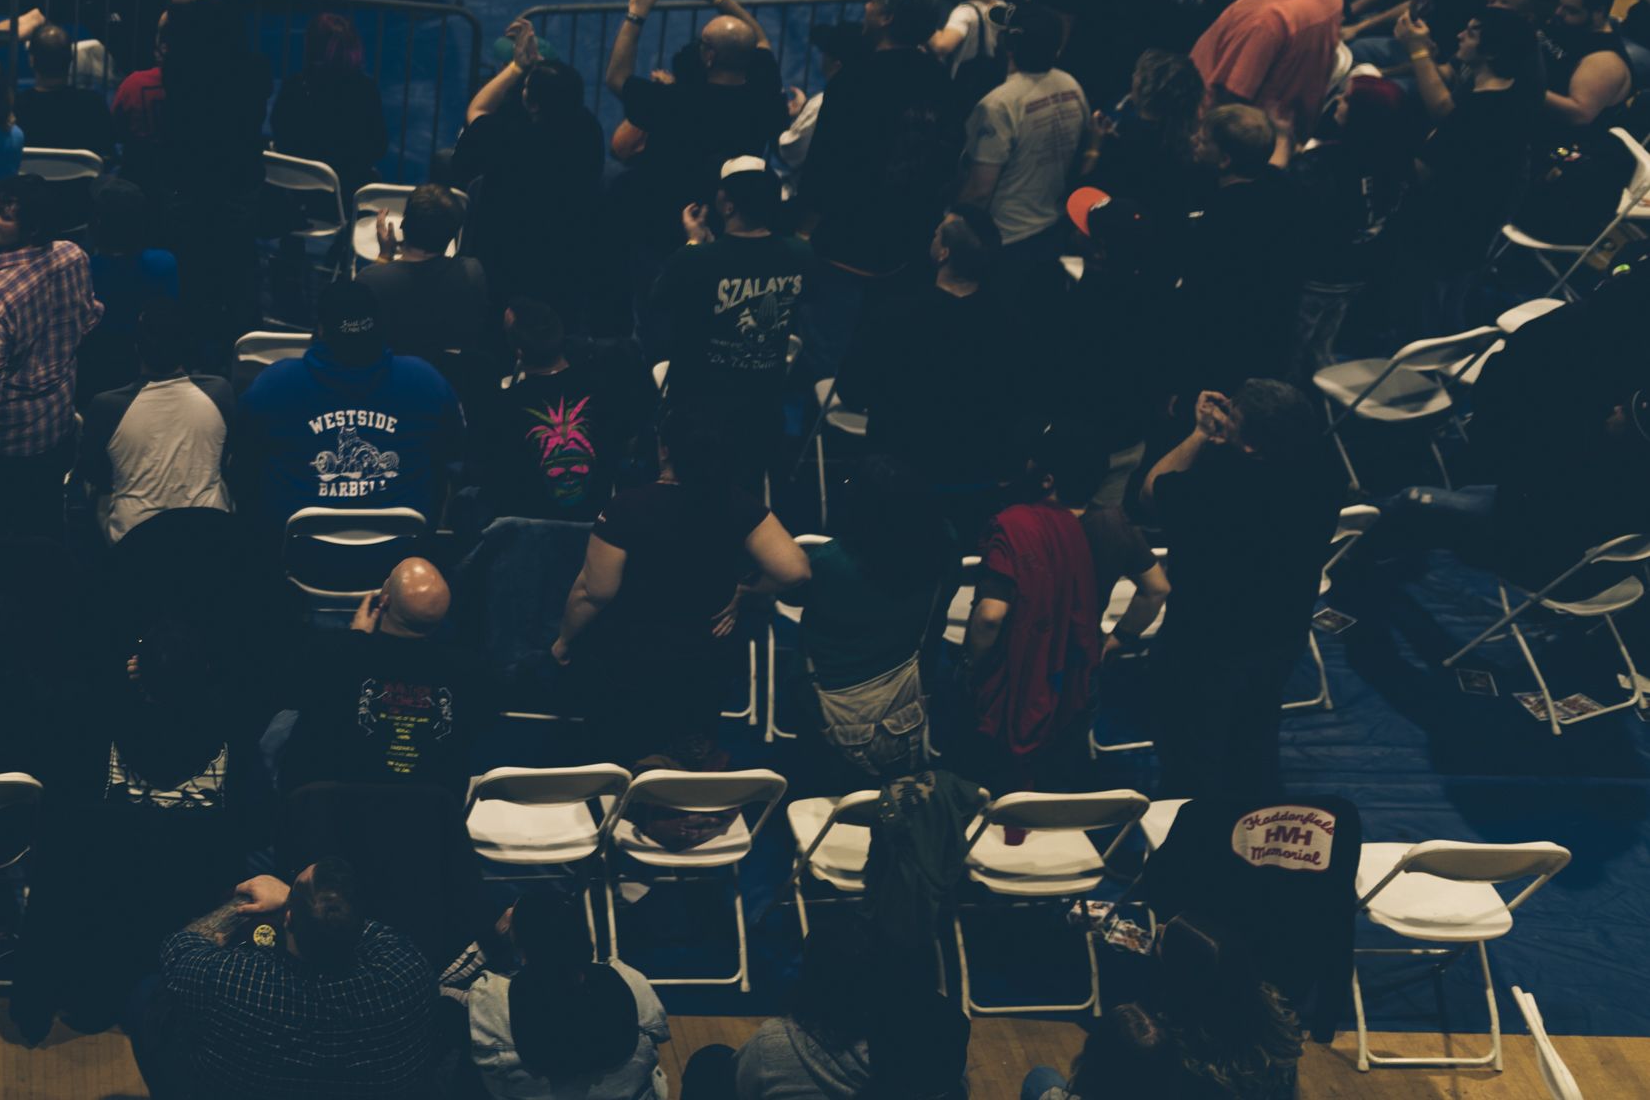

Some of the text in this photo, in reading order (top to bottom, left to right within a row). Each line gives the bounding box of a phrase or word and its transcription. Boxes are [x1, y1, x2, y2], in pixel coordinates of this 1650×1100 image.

[713, 274, 803, 316] SZALAY'S
[308, 408, 399, 435] WESTSIDE
[1250, 846, 1322, 866] Memorial
